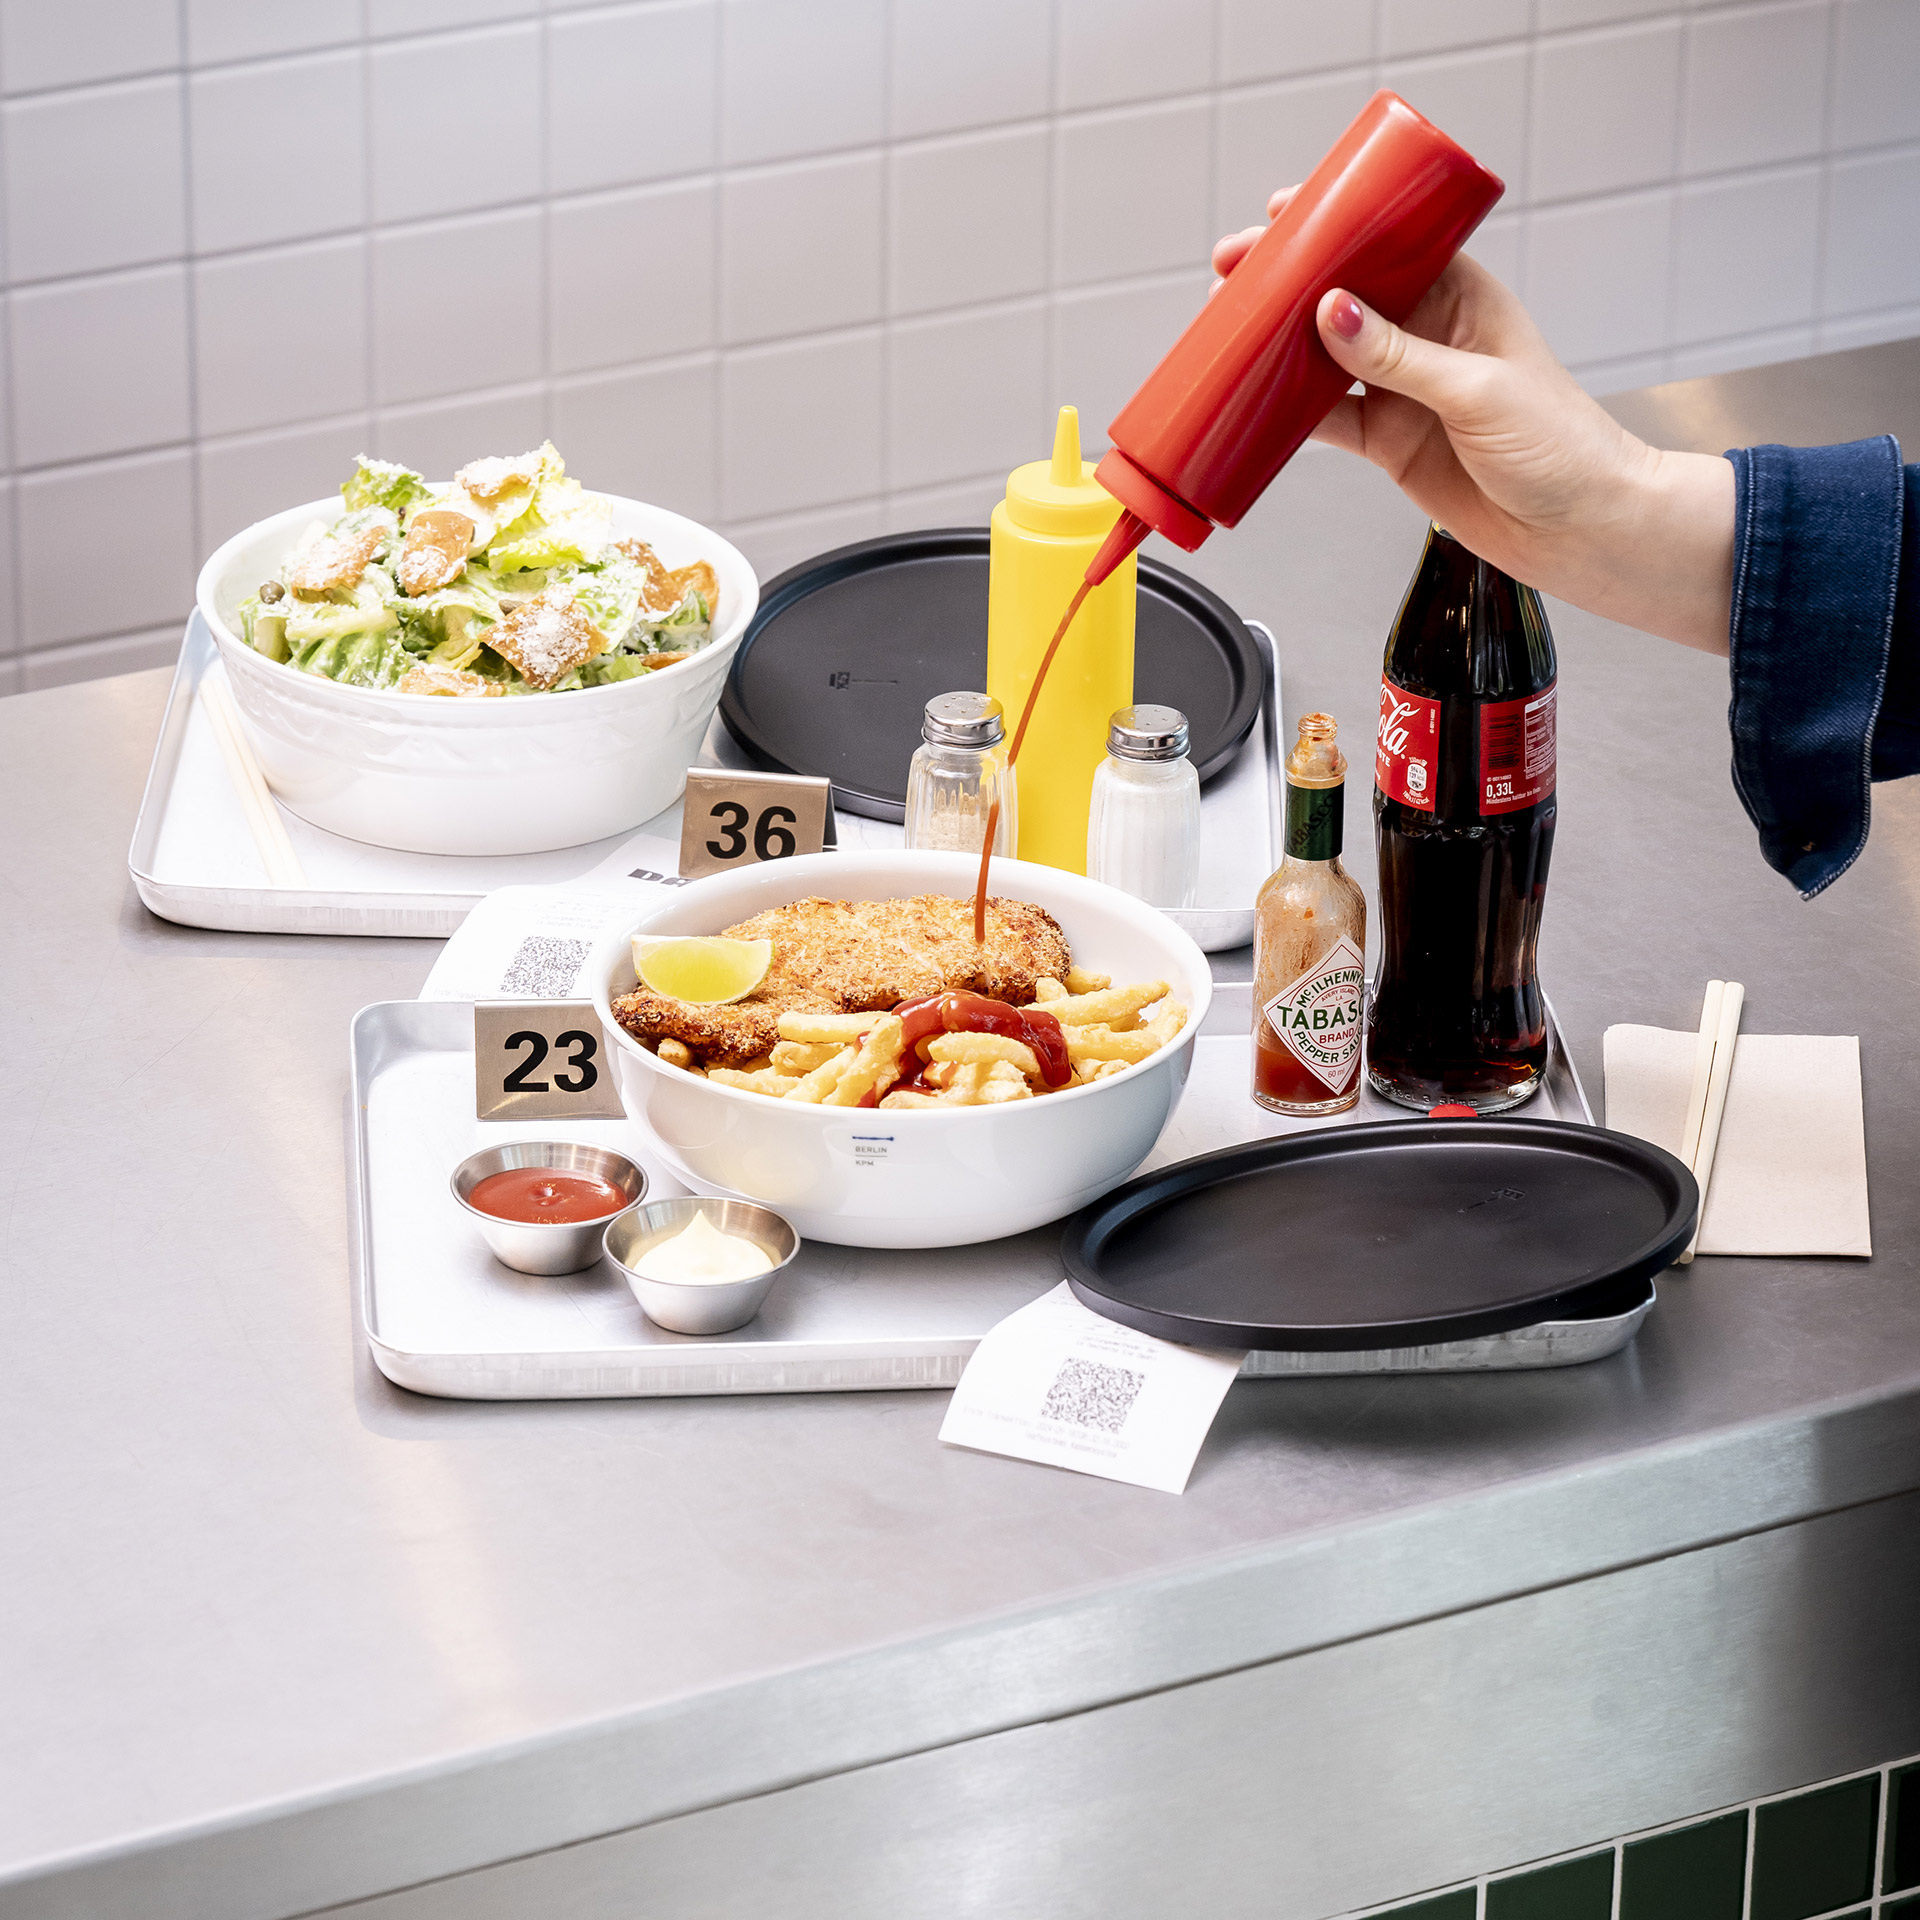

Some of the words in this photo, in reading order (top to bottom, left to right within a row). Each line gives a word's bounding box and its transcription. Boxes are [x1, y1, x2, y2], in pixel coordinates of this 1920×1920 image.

[1486, 782, 1514, 799] 0,33L
[705, 801, 797, 861] 36
[1277, 994, 1363, 1030] TABASC
[1294, 1031, 1339, 1063] PEPPER
[1319, 1028, 1355, 1044] BRAND
[503, 1030, 599, 1093] 23
[1327, 1069, 1337, 1079] 60
[1337, 1067, 1346, 1077] ml
